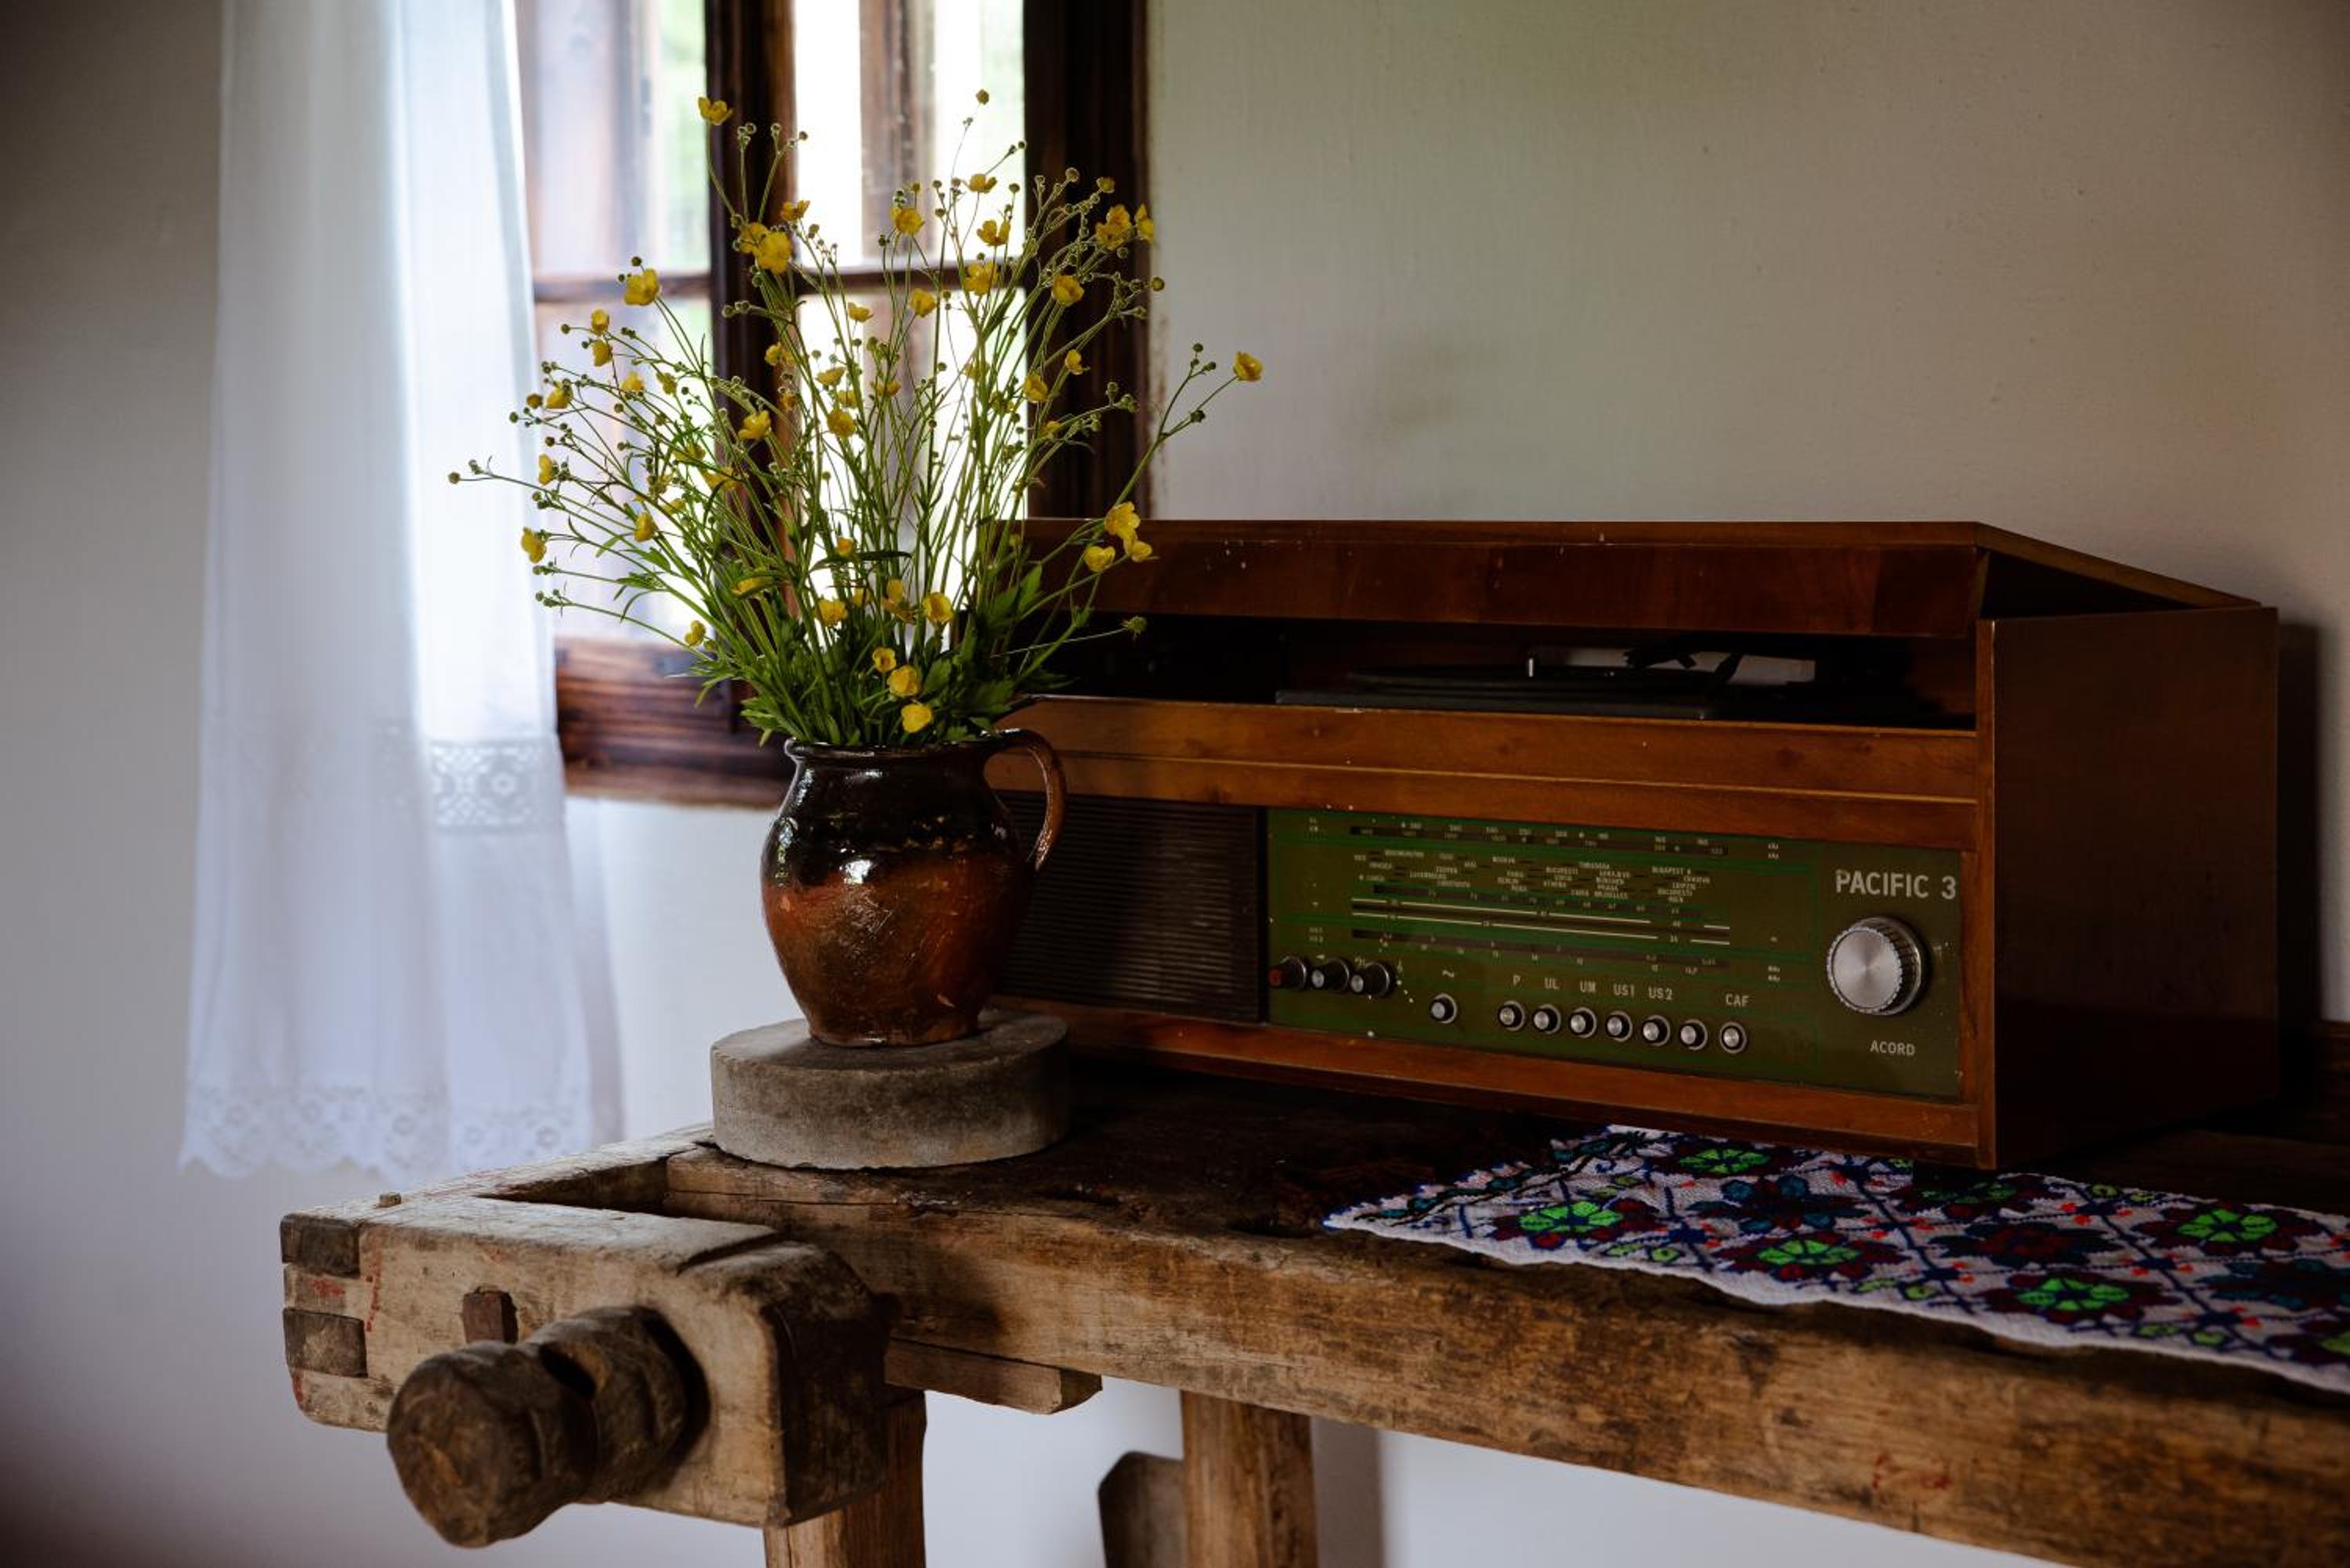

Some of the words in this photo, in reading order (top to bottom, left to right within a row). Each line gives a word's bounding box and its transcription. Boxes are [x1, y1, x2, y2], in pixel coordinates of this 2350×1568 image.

[1835, 868, 1930, 899] PACIFIC
[1941, 874, 1957, 900] 3
[1512, 973, 1521, 986] P
[1544, 977, 1560, 990] UL
[1579, 979, 1596, 994] UM
[1612, 983, 1636, 998] US1
[1647, 986, 1673, 1001] US2
[1724, 992, 1750, 1009] CAF
[1869, 1039, 1917, 1057] ACORD
